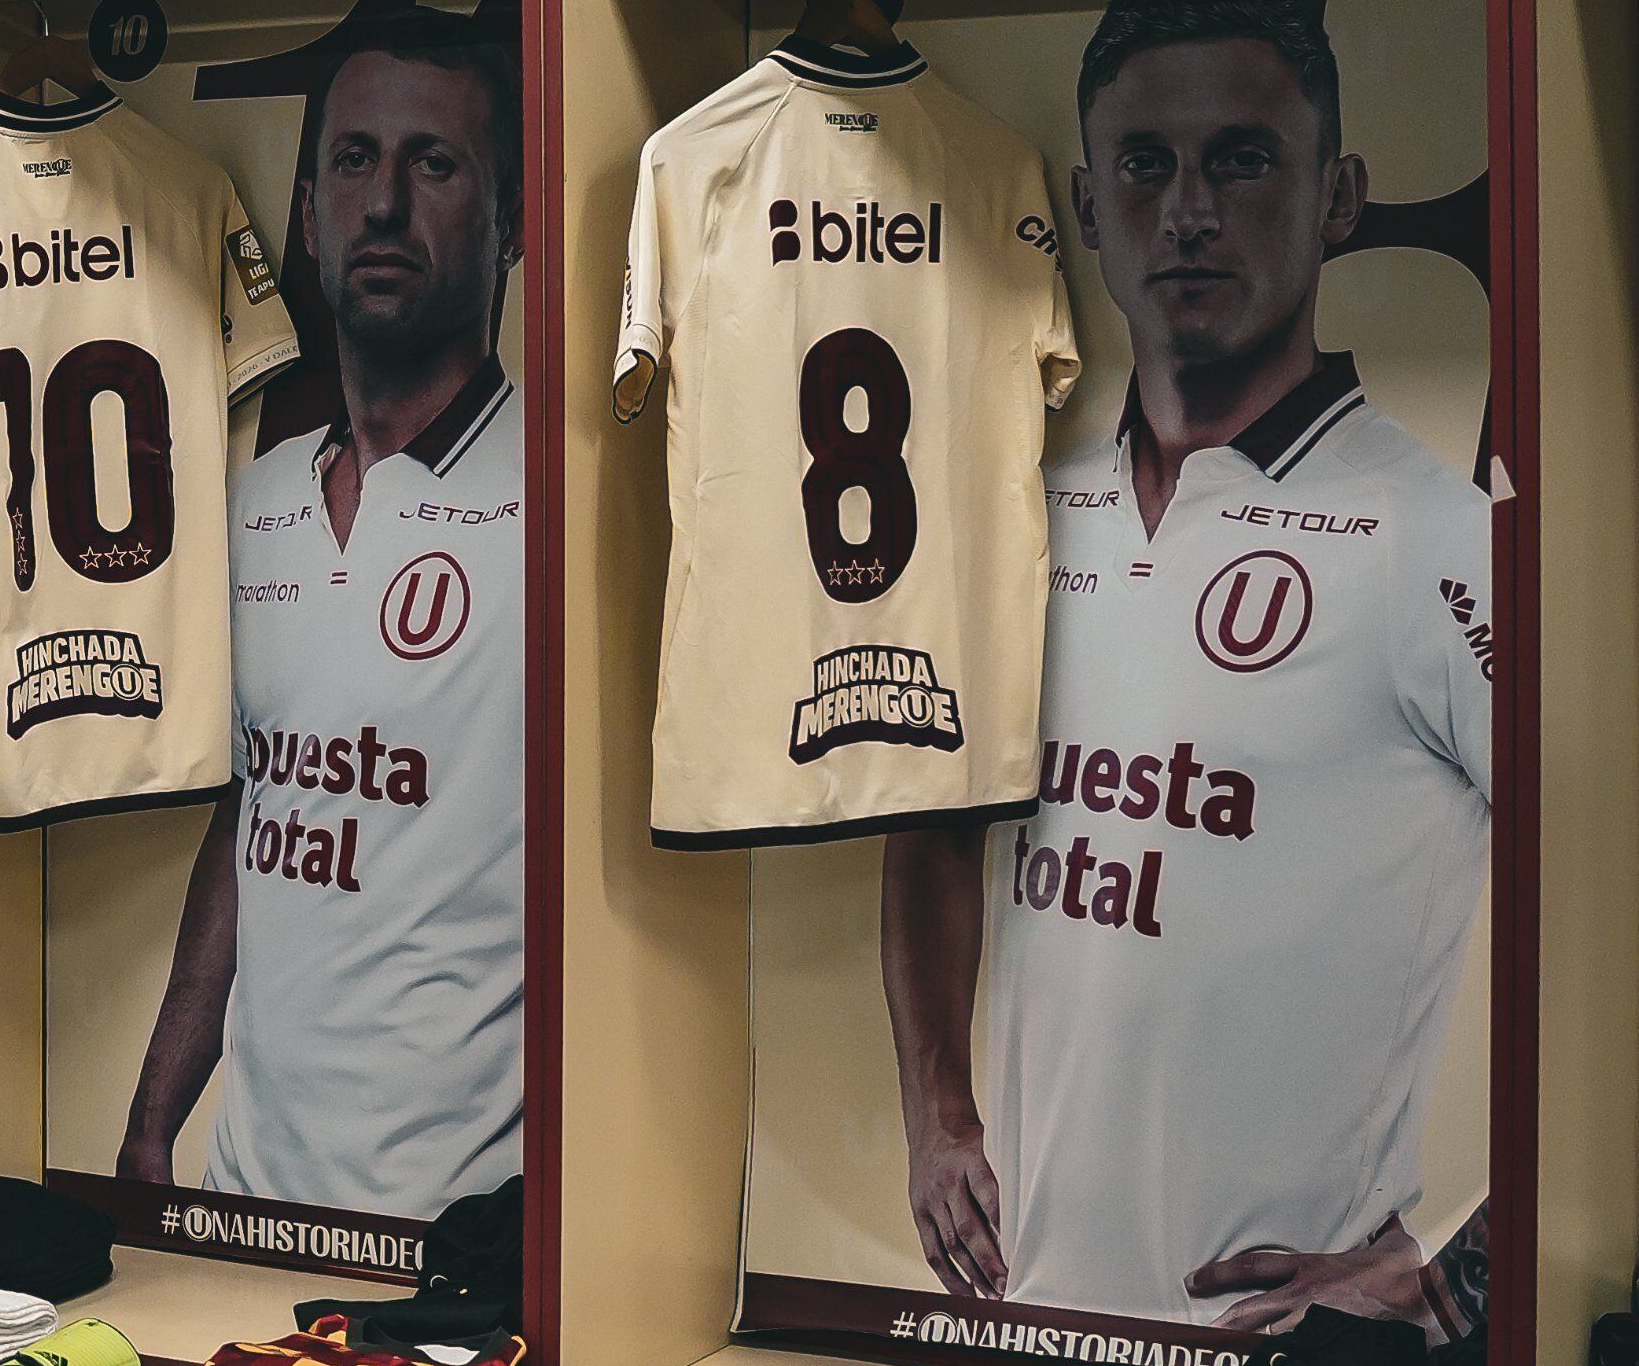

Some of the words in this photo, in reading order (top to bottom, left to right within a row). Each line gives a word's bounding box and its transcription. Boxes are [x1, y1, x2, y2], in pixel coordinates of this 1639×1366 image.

[109, 14, 148, 55] 10
[12, 226, 135, 284] bitel
[811, 201, 942, 264] bitel
[799, 327, 918, 604] 8
[1221, 505, 1380, 536] JETOUR
[398, 572, 451, 637] U
[1218, 571, 1292, 657] U
[22, 634, 142, 680] HINCHADA
[815, 651, 931, 687] HINCHADA
[12, 663, 160, 723] MERENGUE
[800, 680, 957, 744] MERENGUE
[245, 803, 362, 893] total
[1013, 825, 1163, 938] total
